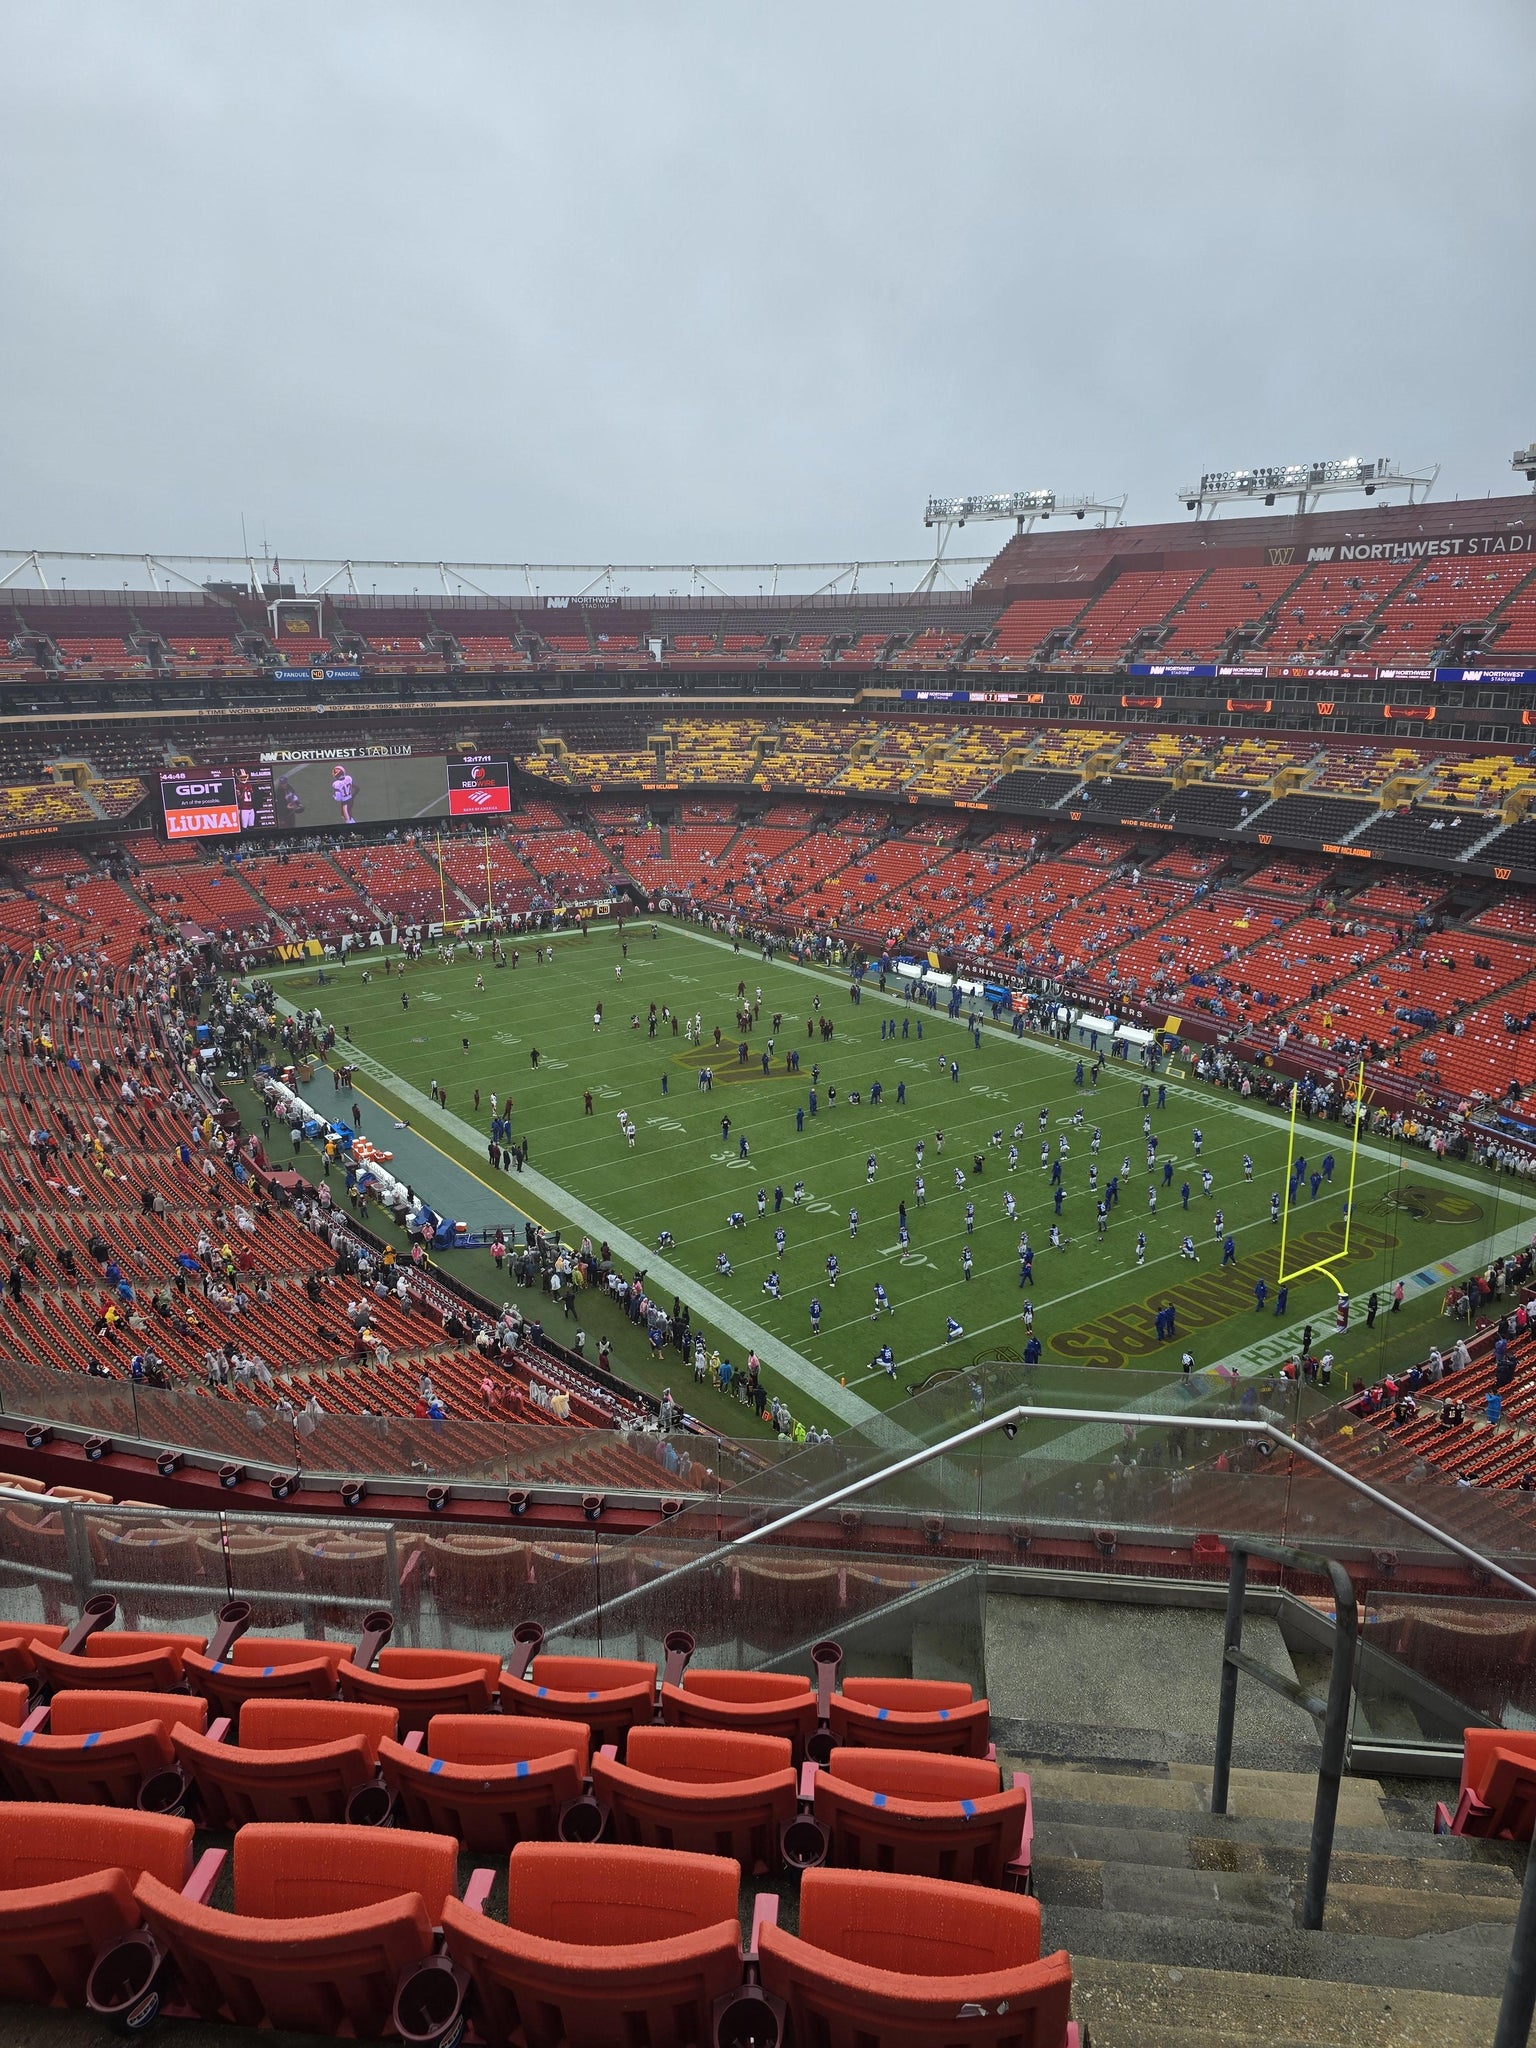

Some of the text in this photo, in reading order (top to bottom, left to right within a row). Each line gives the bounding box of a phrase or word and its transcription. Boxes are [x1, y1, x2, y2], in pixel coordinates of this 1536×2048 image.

[1307, 535, 1532, 562] NW NORTHWEST STADI
[546, 596, 619, 609] NW NORTHWEST
[1150, 666, 1165, 674] NW
[1220, 667, 1232, 675] NW
[1380, 670, 1395, 678] NW
[1462, 671, 1482, 681] NW
[260, 745, 412, 761] NW NORTHWEST STADIUM
[176, 783, 222, 795] GDIT
[462, 779, 495, 788] REDWIRE
[168, 813, 238, 832] LiUNA!
[1140, 821, 1173, 830] RECEIVER
[20, 826, 58, 836] RECEIVER
[1322, 844, 1340, 853] TERRY
[957, 963, 1024, 984] WASHINGTON
[1054, 1051, 1152, 1083] INTECEPT
[1411, 1109, 1435, 1121] 1937
[1506, 1144, 1532, 1158] 1987
[877, 1242, 928, 1267] 10
[1049, 1219, 1401, 1370] COMMANDERS
